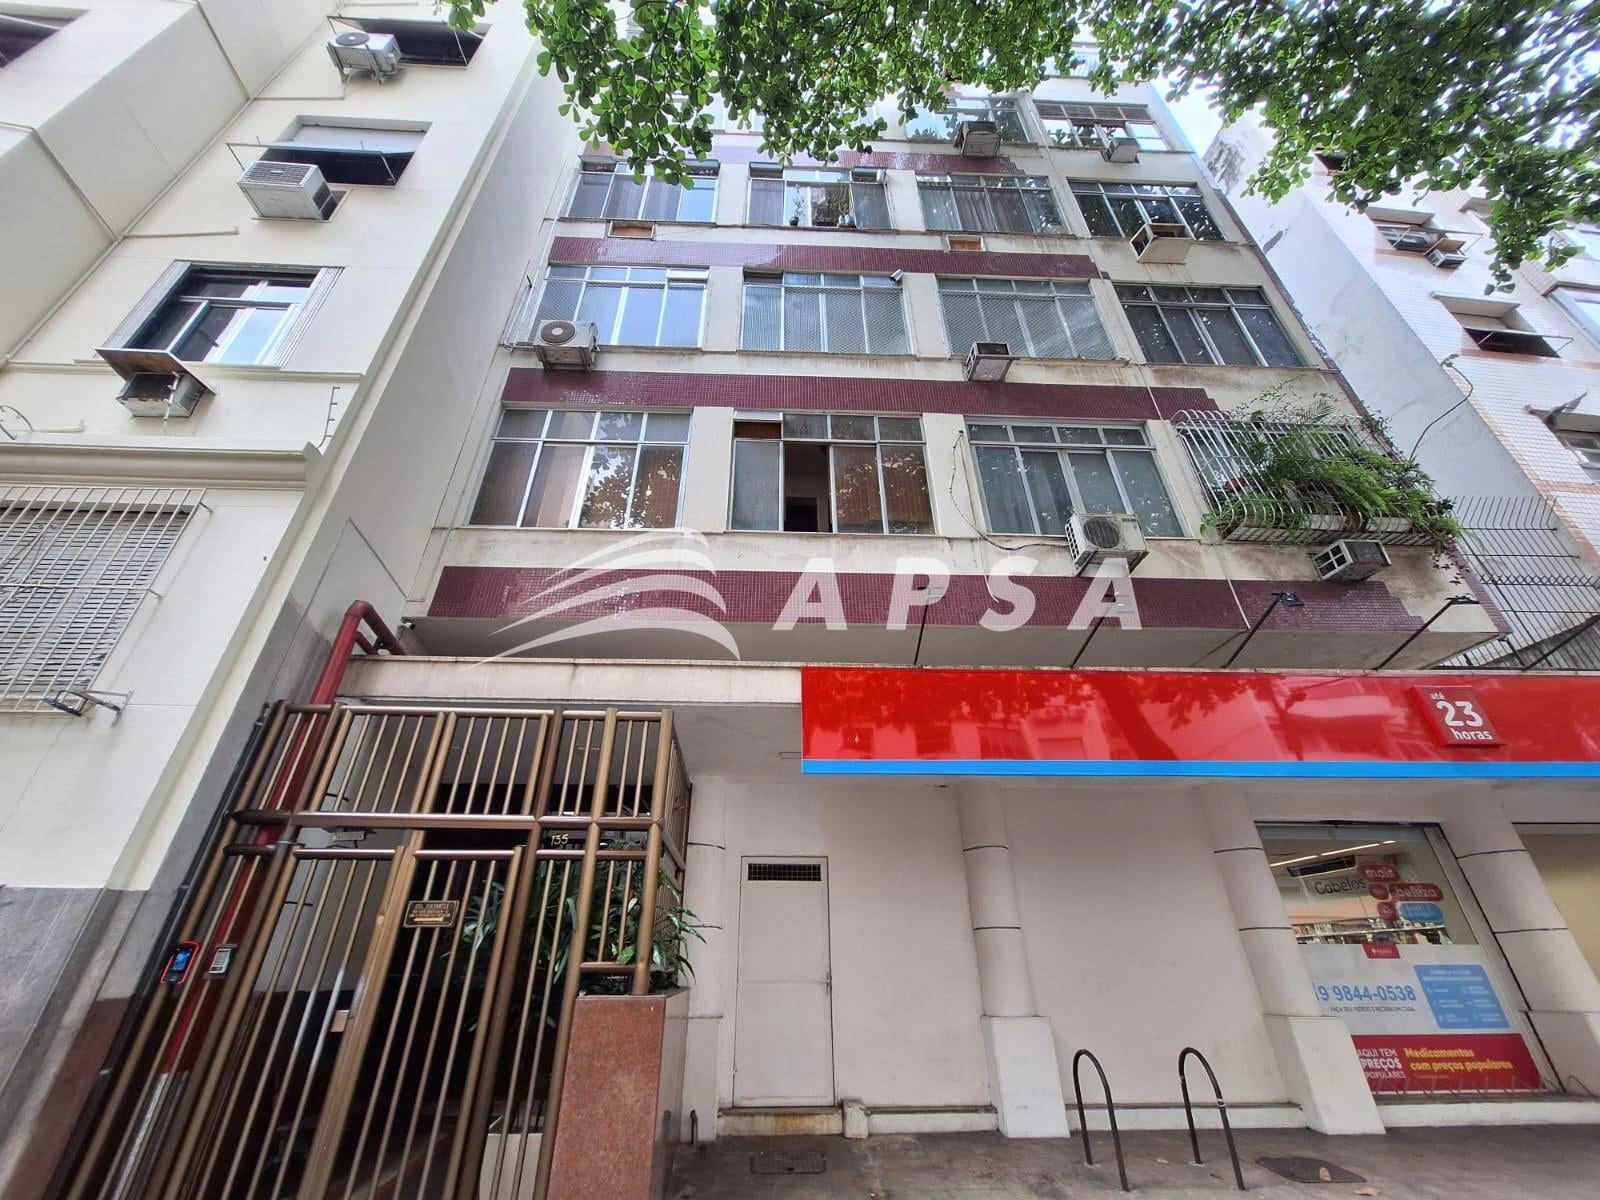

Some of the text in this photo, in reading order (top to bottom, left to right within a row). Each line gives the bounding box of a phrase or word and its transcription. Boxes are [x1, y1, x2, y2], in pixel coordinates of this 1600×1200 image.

[1436, 701, 1484, 727] 23
[1450, 728, 1493, 740] horas
[1365, 867, 1396, 878] mais
[1315, 878, 1367, 895] Cabelos
[1395, 883, 1437, 897] beleza
[1332, 985, 1416, 1001] 9844-0538
[1378, 1048, 1398, 1057] TEM
[1403, 1047, 1475, 1058] Medicamentos
[1359, 1057, 1402, 1071] PREÇOS
[1410, 1059, 1513, 1073] com preços populares
